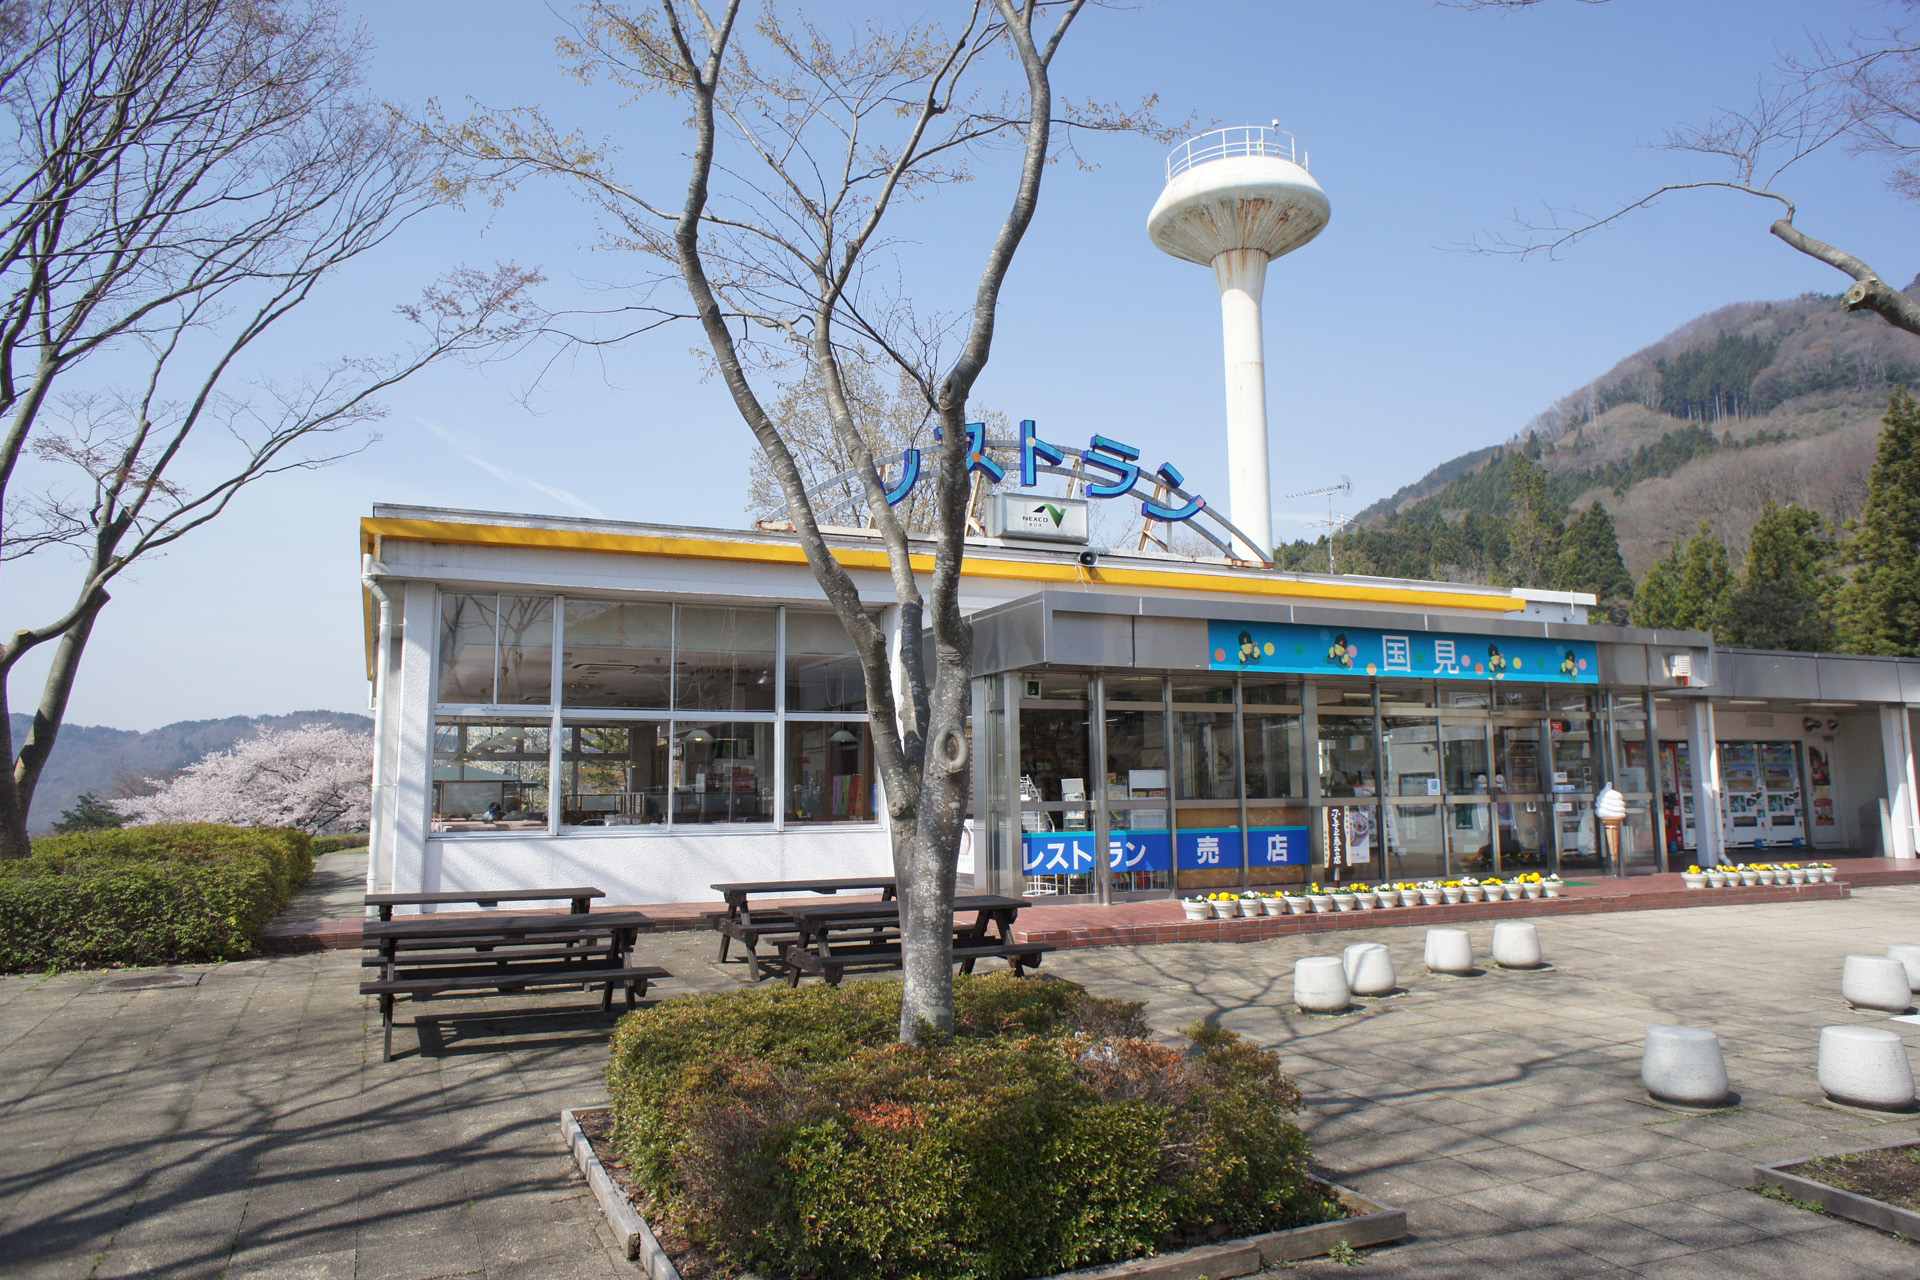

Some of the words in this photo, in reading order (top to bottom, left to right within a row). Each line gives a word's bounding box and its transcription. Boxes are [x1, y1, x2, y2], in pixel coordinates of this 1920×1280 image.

[1382, 634, 1460, 674] 国見
[1022, 840, 1147, 871] レストラン
